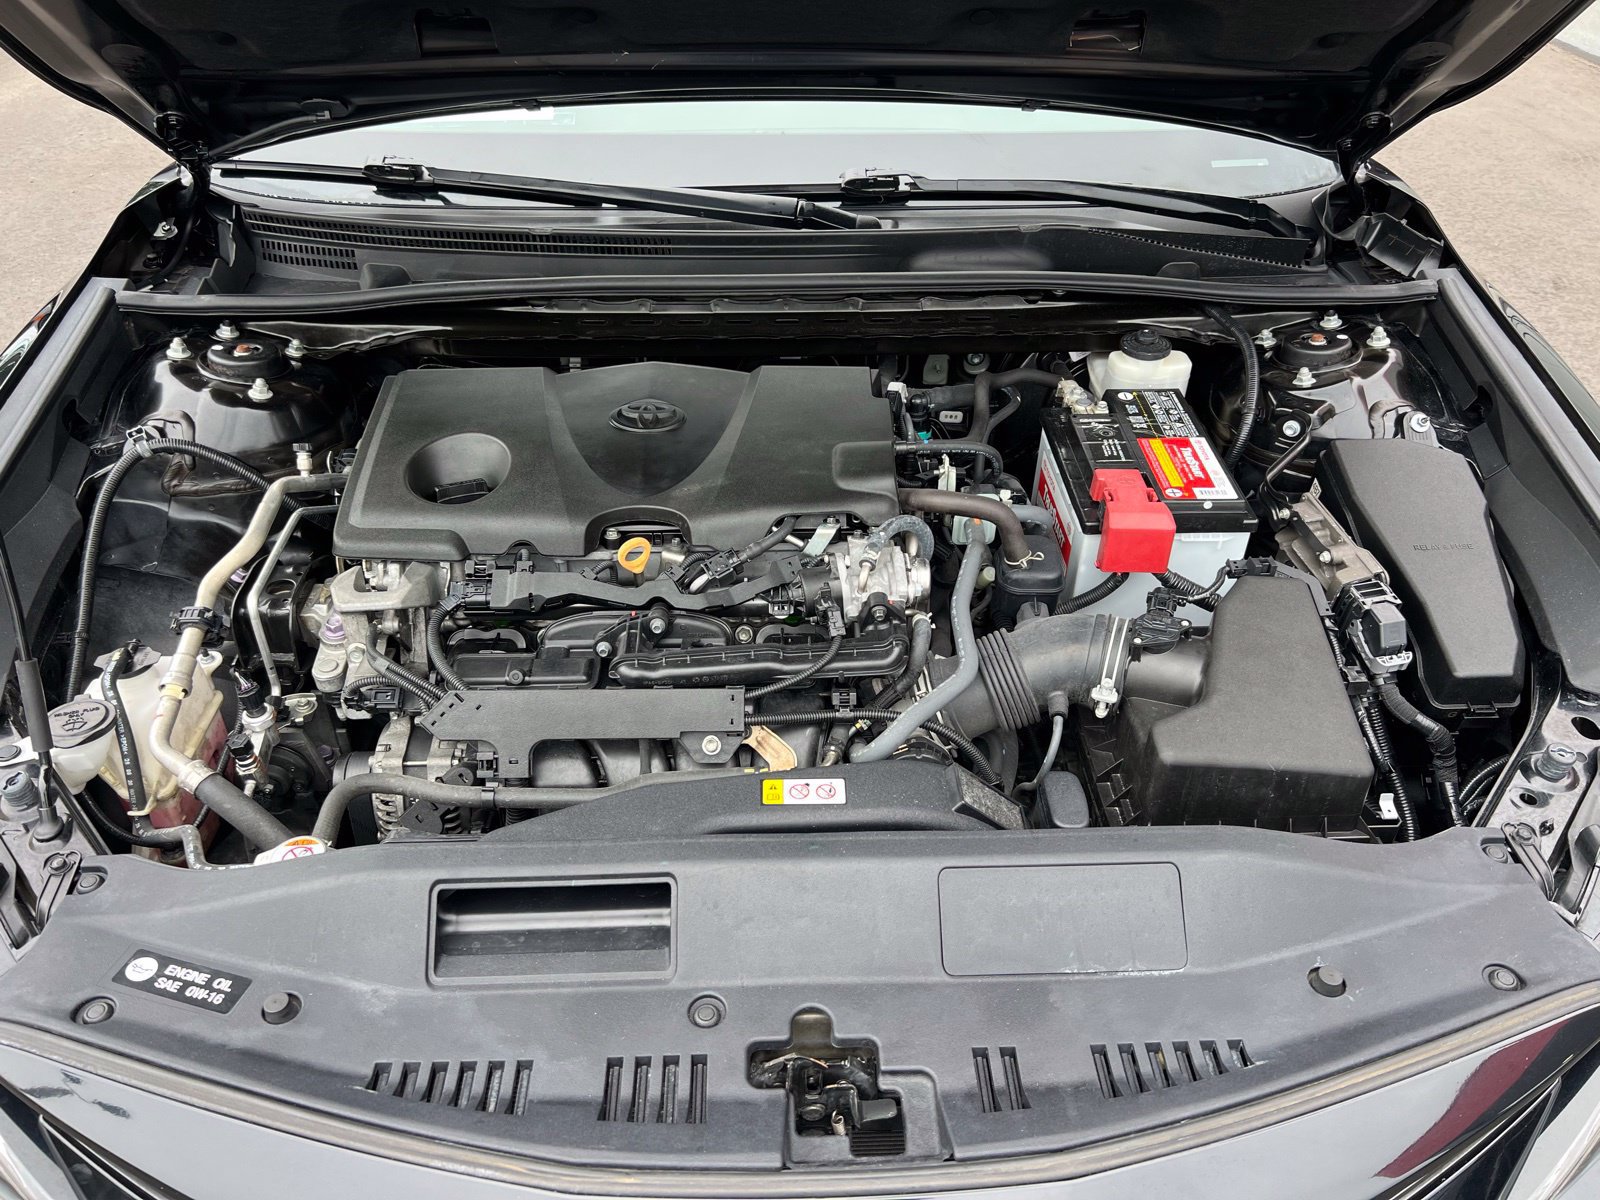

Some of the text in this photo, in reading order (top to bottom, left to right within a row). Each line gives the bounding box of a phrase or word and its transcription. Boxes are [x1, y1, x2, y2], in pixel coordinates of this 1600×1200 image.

[154, 977, 225, 1005] SAE 0W-16
[164, 965, 233, 992] ENGINE OIL
